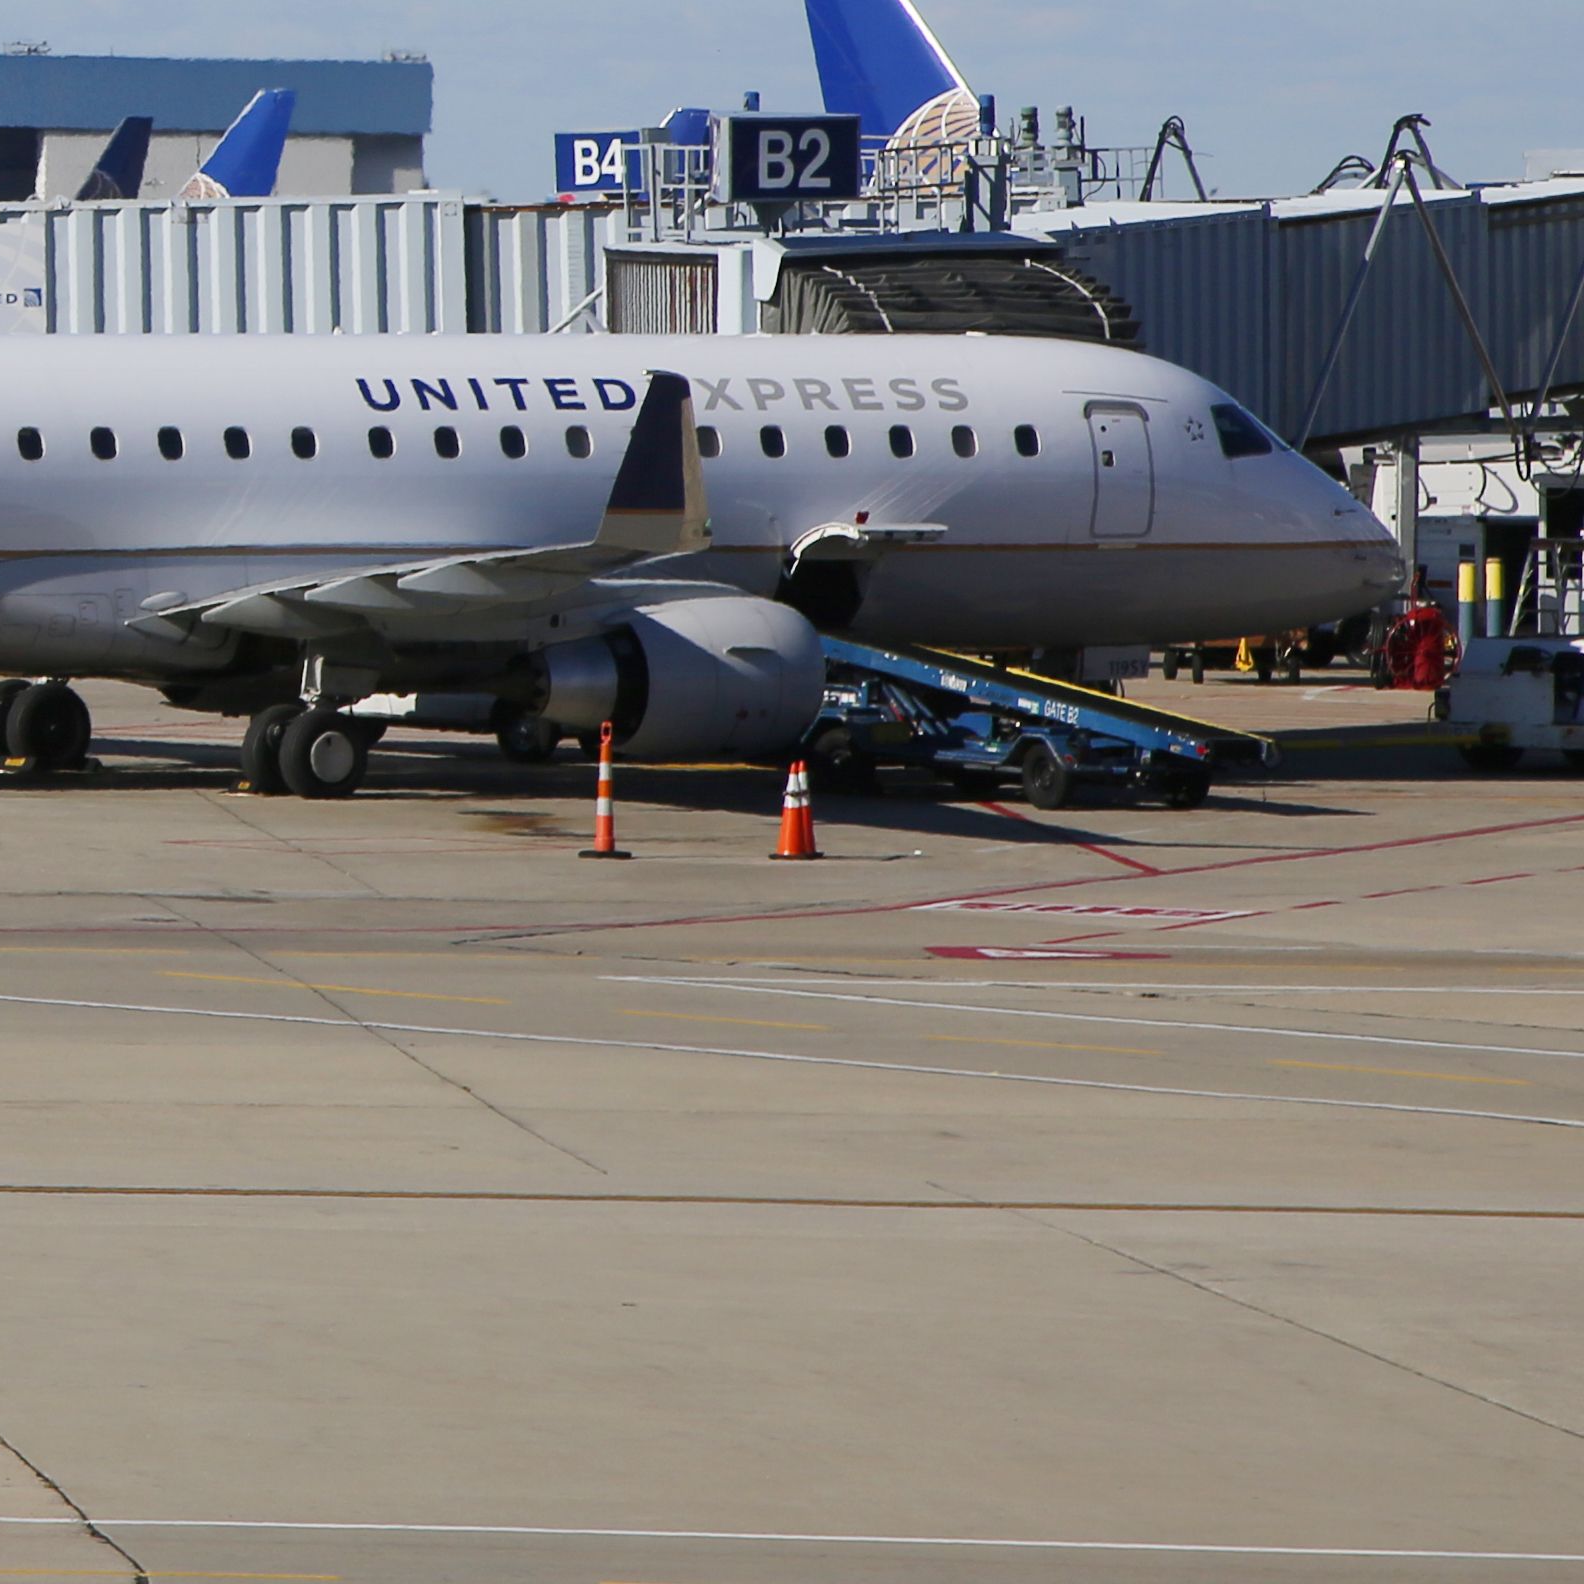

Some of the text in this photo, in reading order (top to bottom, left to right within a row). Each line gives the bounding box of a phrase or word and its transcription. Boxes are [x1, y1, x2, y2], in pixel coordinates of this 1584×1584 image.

[573, 137, 624, 186] B4
[756, 128, 832, 190] B2
[355, 377, 970, 413] UNITED XPRESS
[1043, 699, 1067, 722] GATE
